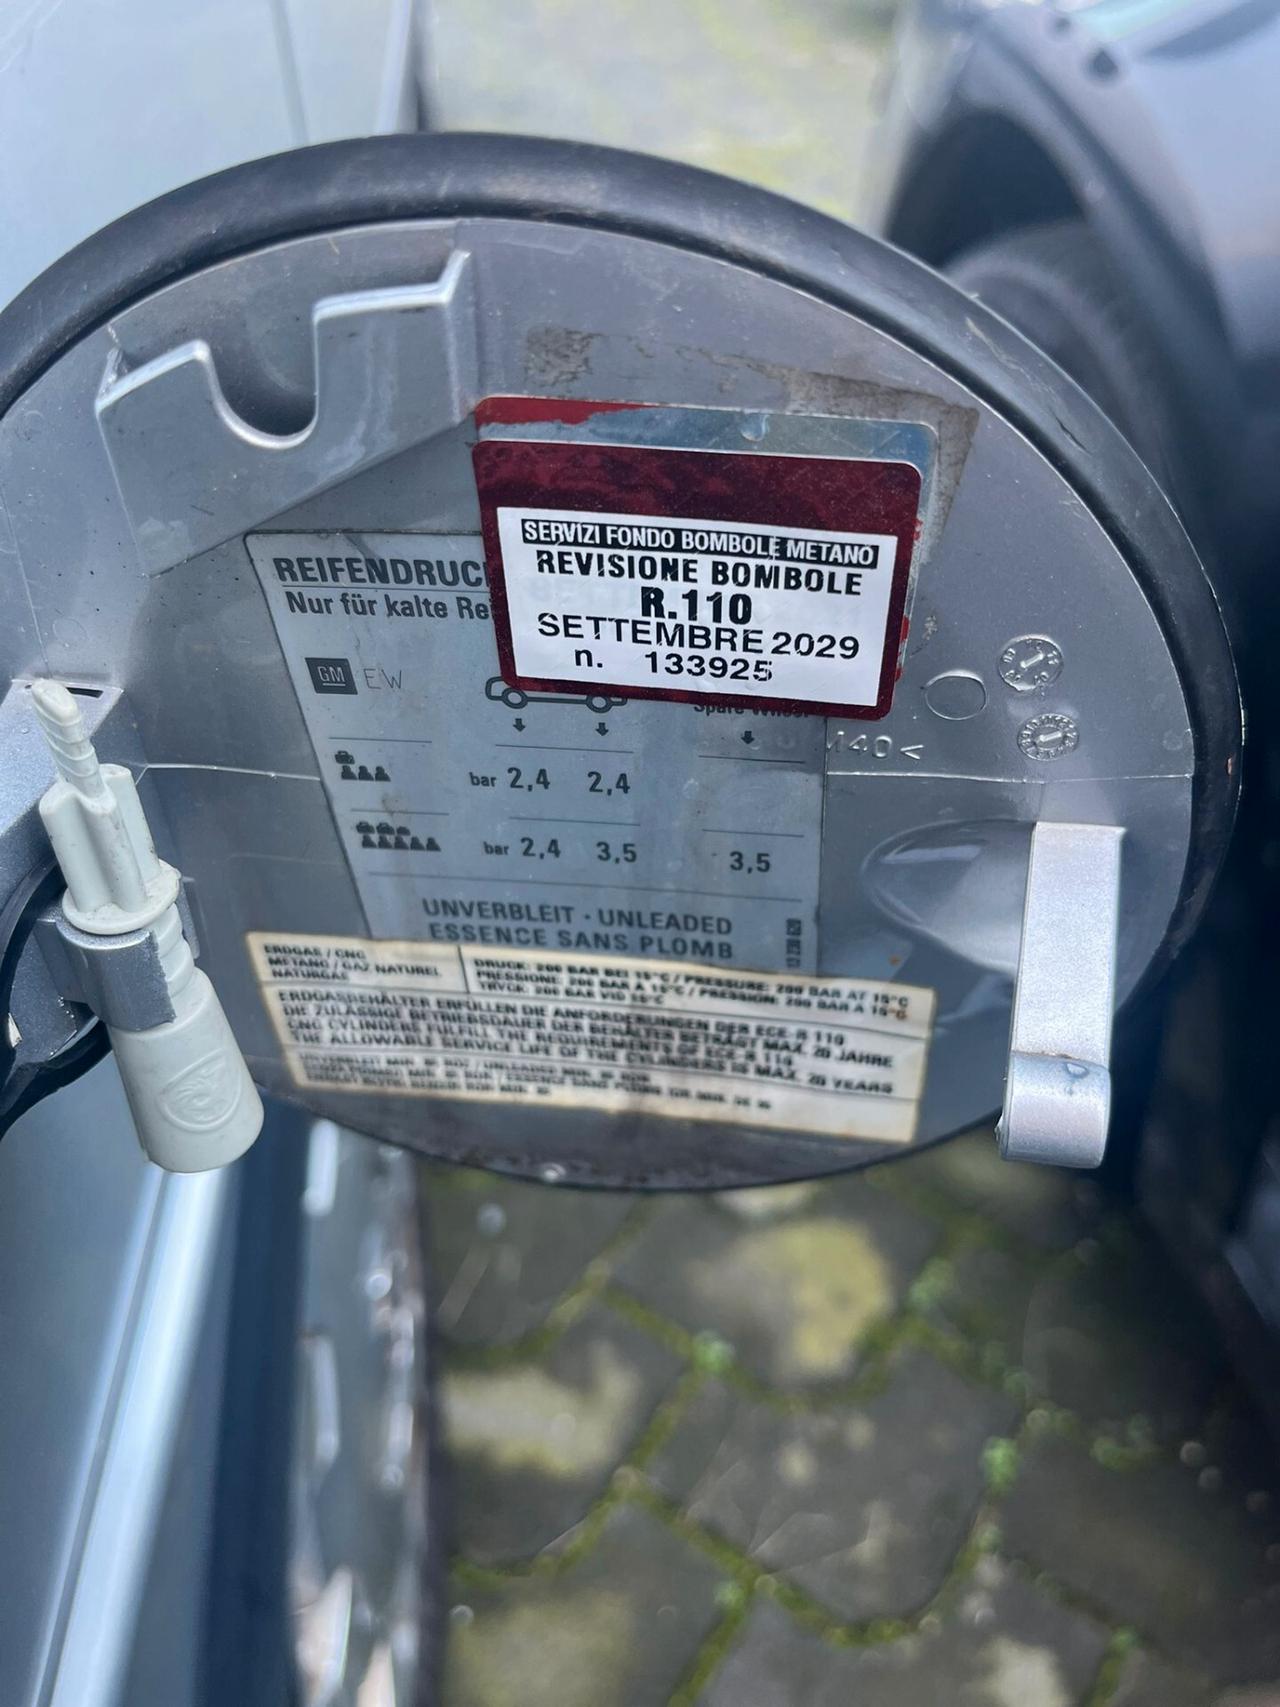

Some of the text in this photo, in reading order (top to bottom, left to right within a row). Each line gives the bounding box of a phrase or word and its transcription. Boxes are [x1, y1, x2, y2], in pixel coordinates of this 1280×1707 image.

[524, 520, 874, 566] SERVIZI FONDO BOMBOLE METANO
[536, 549, 863, 596] REVISIONE BOMBOLE
[285, 591, 333, 614] Nur
[340, 593, 378, 616] für
[384, 594, 448, 619] kalte
[641, 586, 753, 626] R.110
[537, 612, 860, 660] SETTEMBRE 2029
[317, 666, 346, 683] GM
[575, 648, 773, 682] n. 133925
[469, 767, 631, 796] bar 2,4 2,4
[483, 837, 771, 875] bar 2,4 3,5 3,5
[422, 898, 575, 924] UNVERBLEIT
[598, 908, 733, 936] UNLEADED
[264, 944, 322, 957] ERDGAS
[335, 948, 367, 960] CNG
[429, 923, 734, 961] ESSENCE SANS PLOMB
[268, 957, 330, 970] METANO
[375, 964, 441, 977] NATUREL
[567, 964, 600, 976] BAR
[604, 967, 629, 979] BEI
[808, 986, 842, 999] BAR
[847, 989, 866, 1001] AT
[600, 979, 630, 990] BAR
[817, 1000, 849, 1013] BAR
